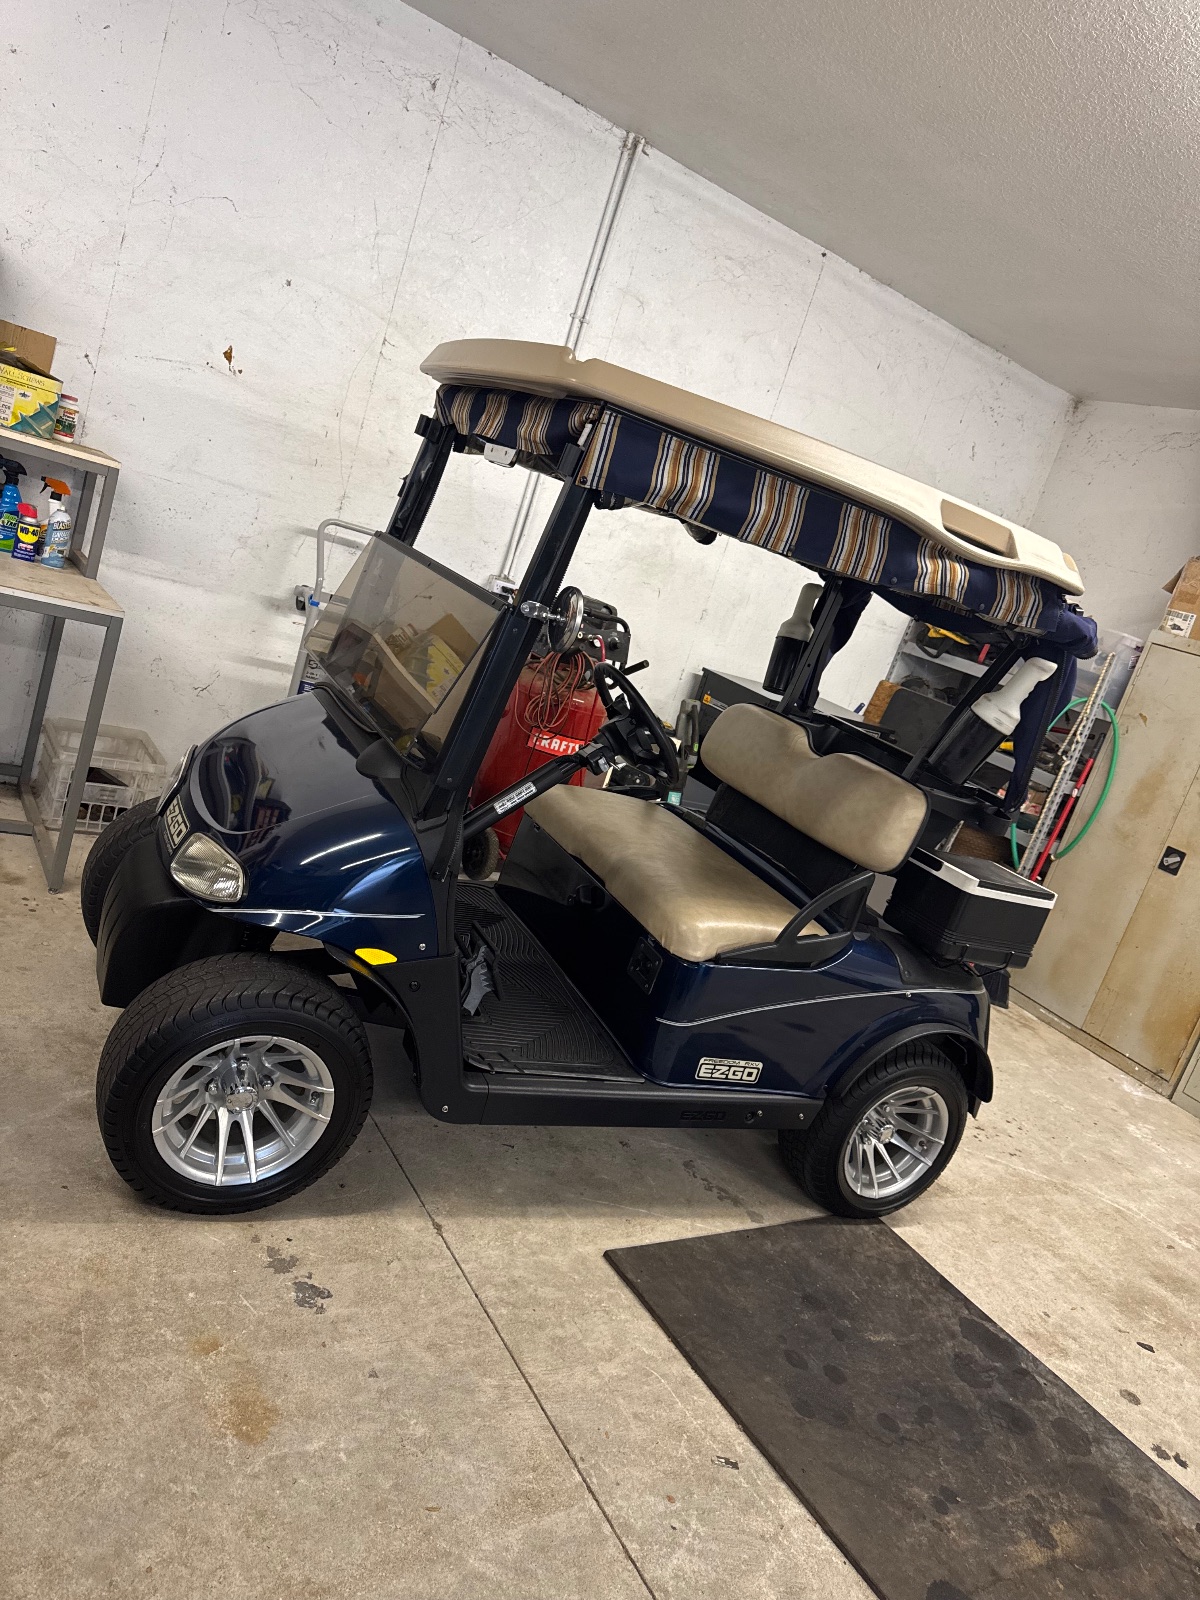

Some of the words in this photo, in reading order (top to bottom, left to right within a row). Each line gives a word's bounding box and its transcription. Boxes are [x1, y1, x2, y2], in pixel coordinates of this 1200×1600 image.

[20, 526, 39, 537] WD-40
[703, 1058, 741, 1066] FREEDOM
[698, 1064, 759, 1081] EZGO
